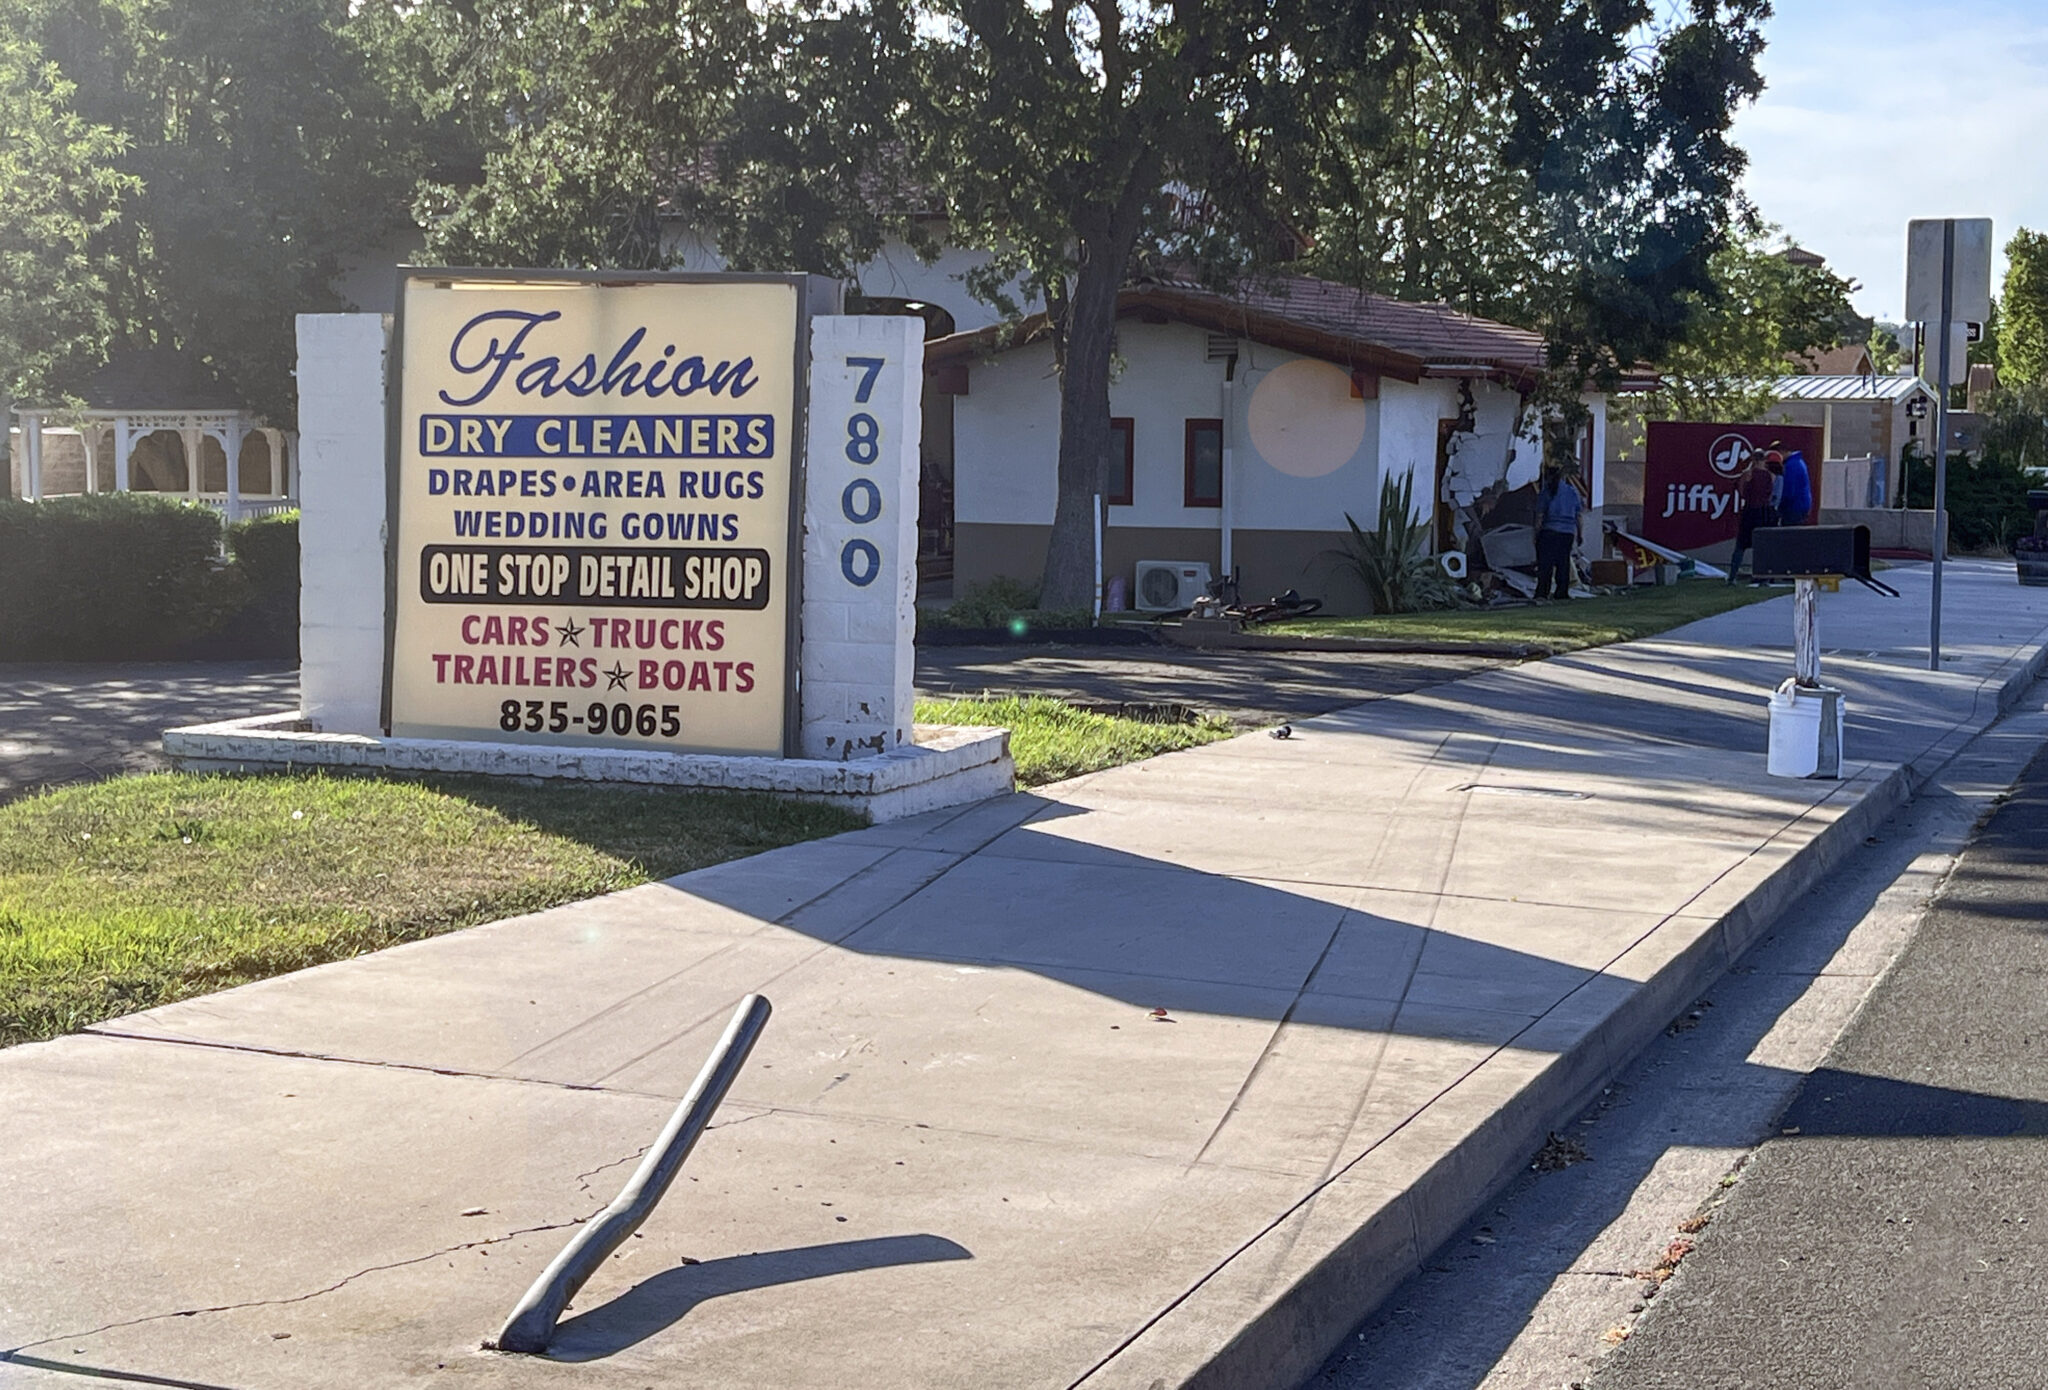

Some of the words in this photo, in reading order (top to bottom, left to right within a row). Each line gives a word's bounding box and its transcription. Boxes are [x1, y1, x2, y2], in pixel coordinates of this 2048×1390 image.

[438, 310, 759, 406] Fashion
[426, 419, 513, 453] DRY
[535, 419, 768, 455] CLEANERS
[428, 469, 557, 497] DRAPES
[580, 470, 666, 498] AREA
[679, 470, 764, 499] RUGS
[841, 357, 885, 587] 7800
[1662, 483, 1730, 520] jiffy
[454, 510, 607, 539] WEDDING
[621, 512, 739, 541] GOWNS
[429, 552, 488, 595] ONE
[499, 553, 570, 597] STOP
[579, 555, 676, 599] DETAIL
[684, 556, 763, 600] SHOP
[461, 615, 550, 646] CARS
[589, 617, 725, 651] TRUCKS
[432, 654, 598, 688] TRAILERS
[638, 660, 755, 693] BOATS
[500, 699, 681, 737] 835-9065
